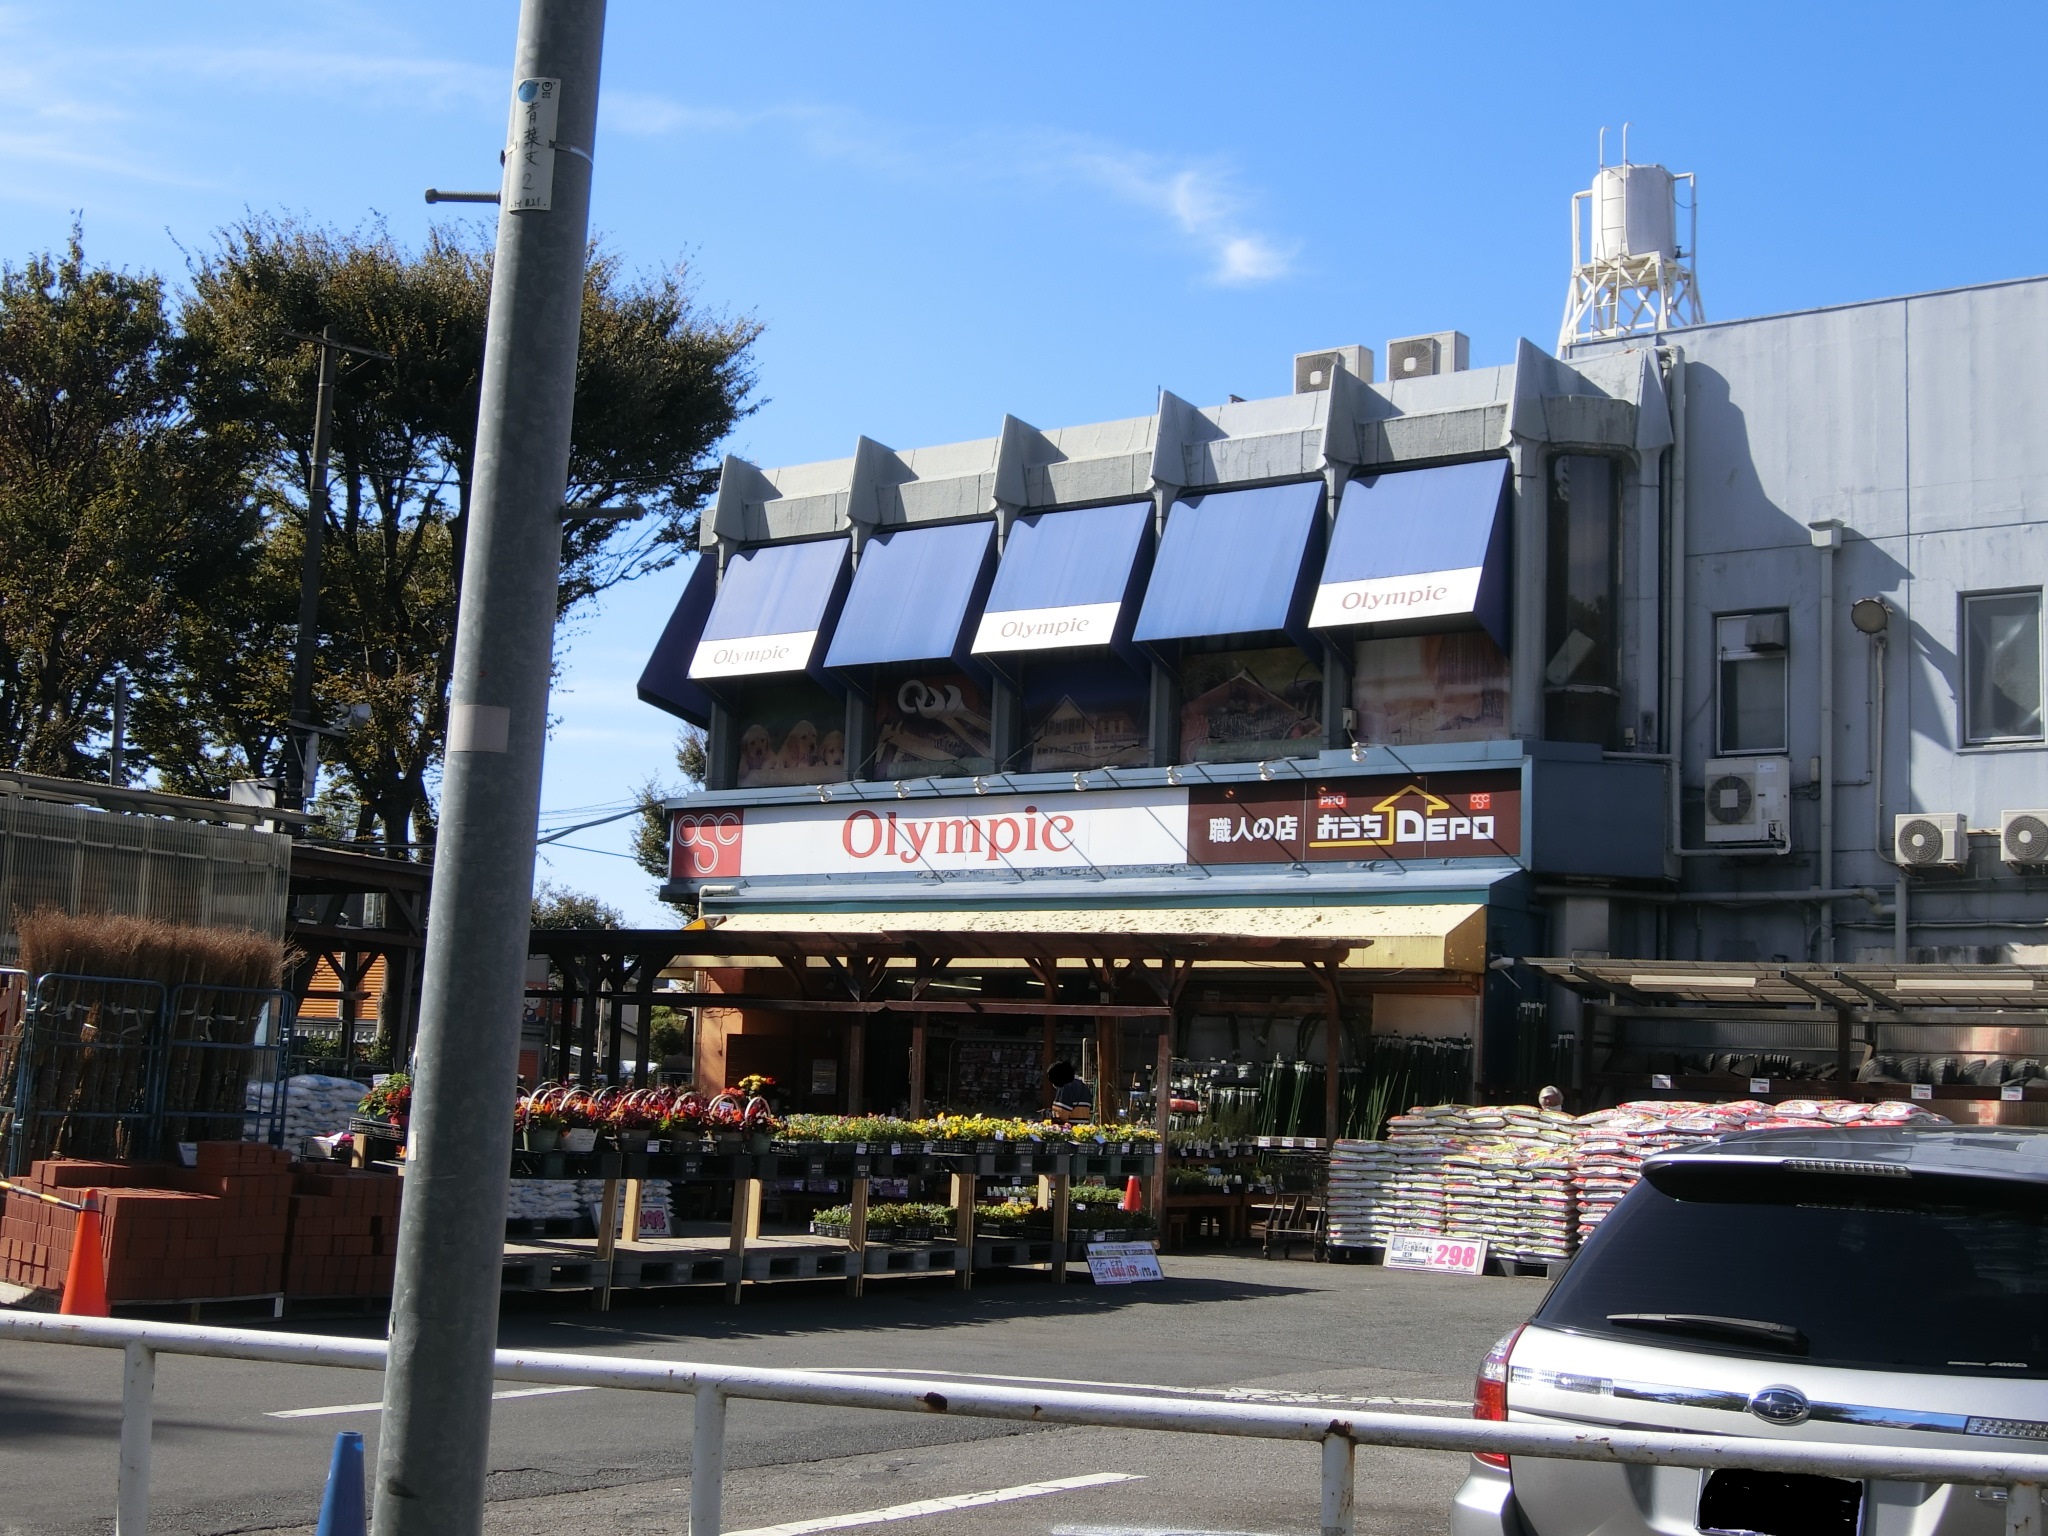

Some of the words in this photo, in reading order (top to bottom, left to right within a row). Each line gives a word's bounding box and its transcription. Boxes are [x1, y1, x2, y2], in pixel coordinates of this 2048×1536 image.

[1341, 585, 1448, 610] Olympic
[1001, 617, 1090, 639] Olympic
[713, 645, 790, 665] Olympic
[1320, 796, 1345, 807] PRO
[841, 805, 1075, 864] Olympic
[1208, 814, 1298, 843] 職人の店
[1434, 1244, 1477, 1267] 298
